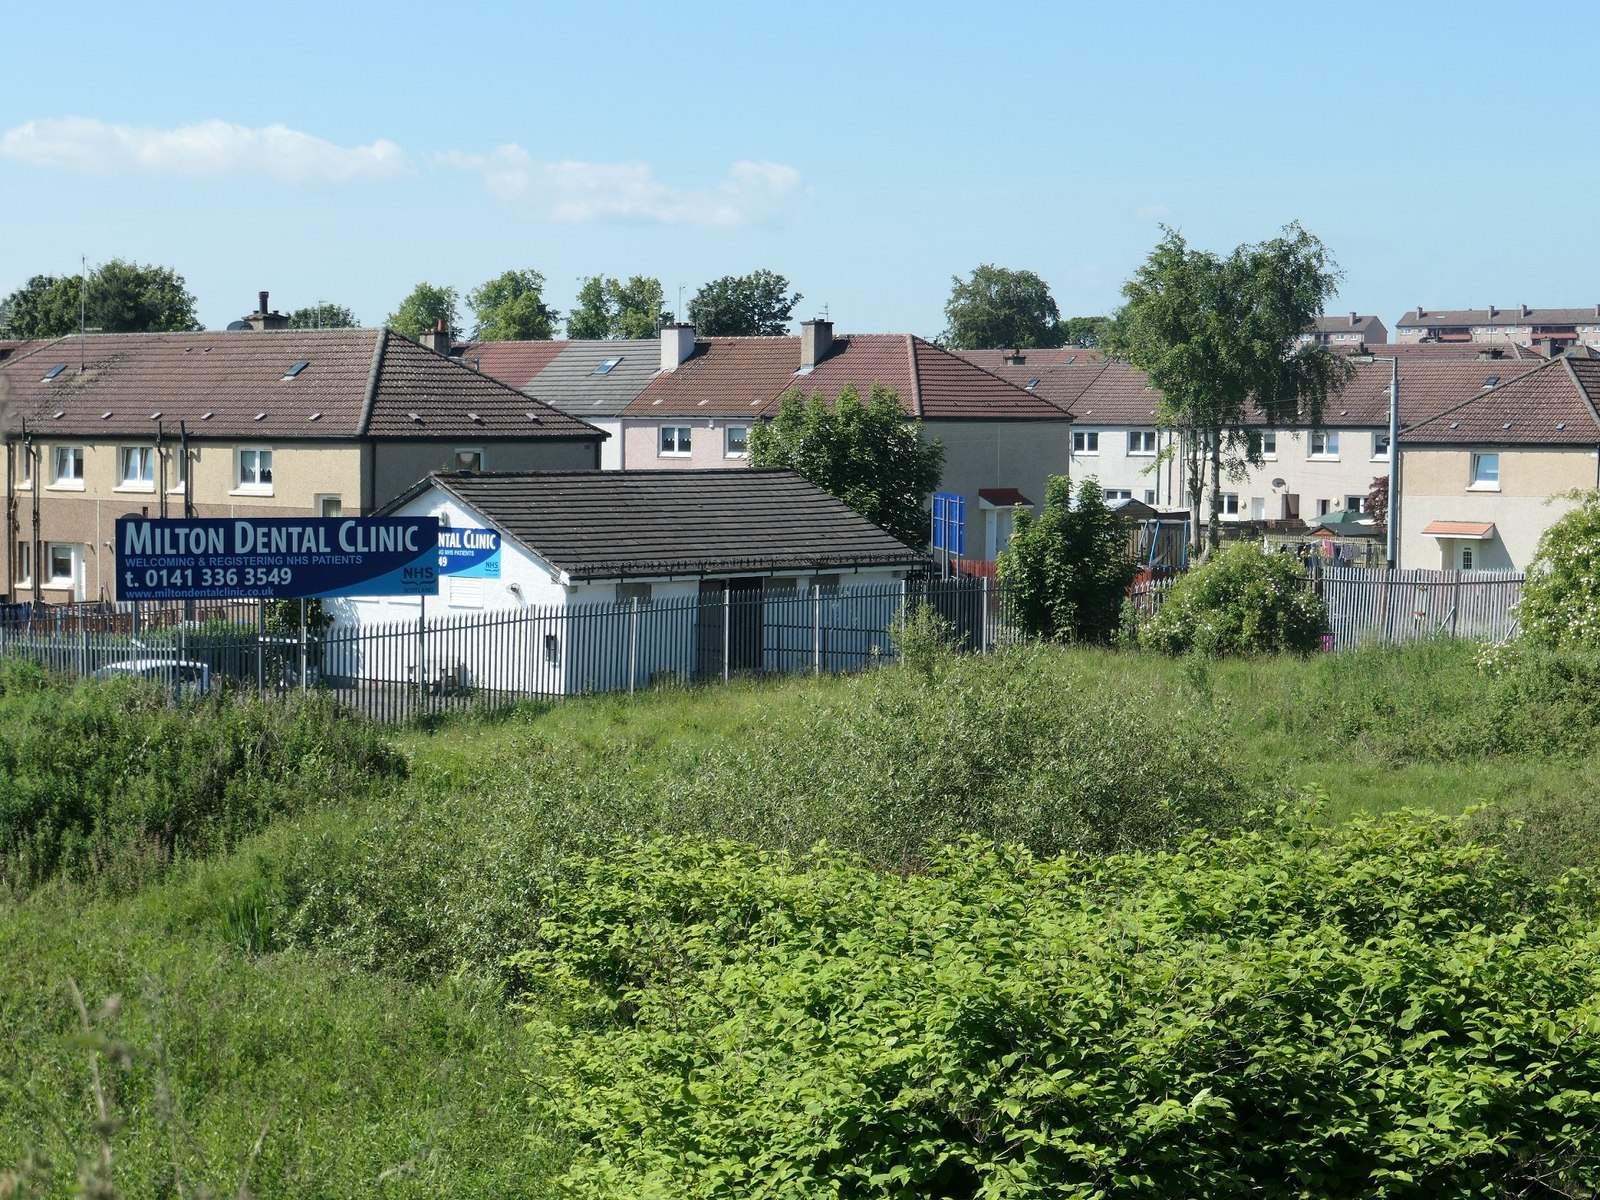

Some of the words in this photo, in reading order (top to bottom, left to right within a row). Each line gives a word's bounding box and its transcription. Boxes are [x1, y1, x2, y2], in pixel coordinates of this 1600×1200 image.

[125, 522, 224, 555] MILTON
[235, 521, 331, 554] DENTAL
[339, 520, 418, 553] CLINIC
[438, 532, 461, 548] NTAL
[463, 529, 496, 550] CLINIC
[125, 557, 195, 567] WELCOMING
[198, 557, 206, 566] &
[209, 556, 283, 566] REGISTERING
[287, 556, 309, 565] NHS
[312, 555, 362, 565] PATIENTS
[438, 556, 448, 567] 49
[485, 561, 498, 569] NHS
[125, 571, 139, 587] t.
[145, 568, 193, 587] 0141
[201, 568, 238, 586] 336
[244, 567, 292, 585] 3549
[403, 567, 433, 579] NHS
[126, 586, 274, 599] www.miltondentalclinic.co.uk
